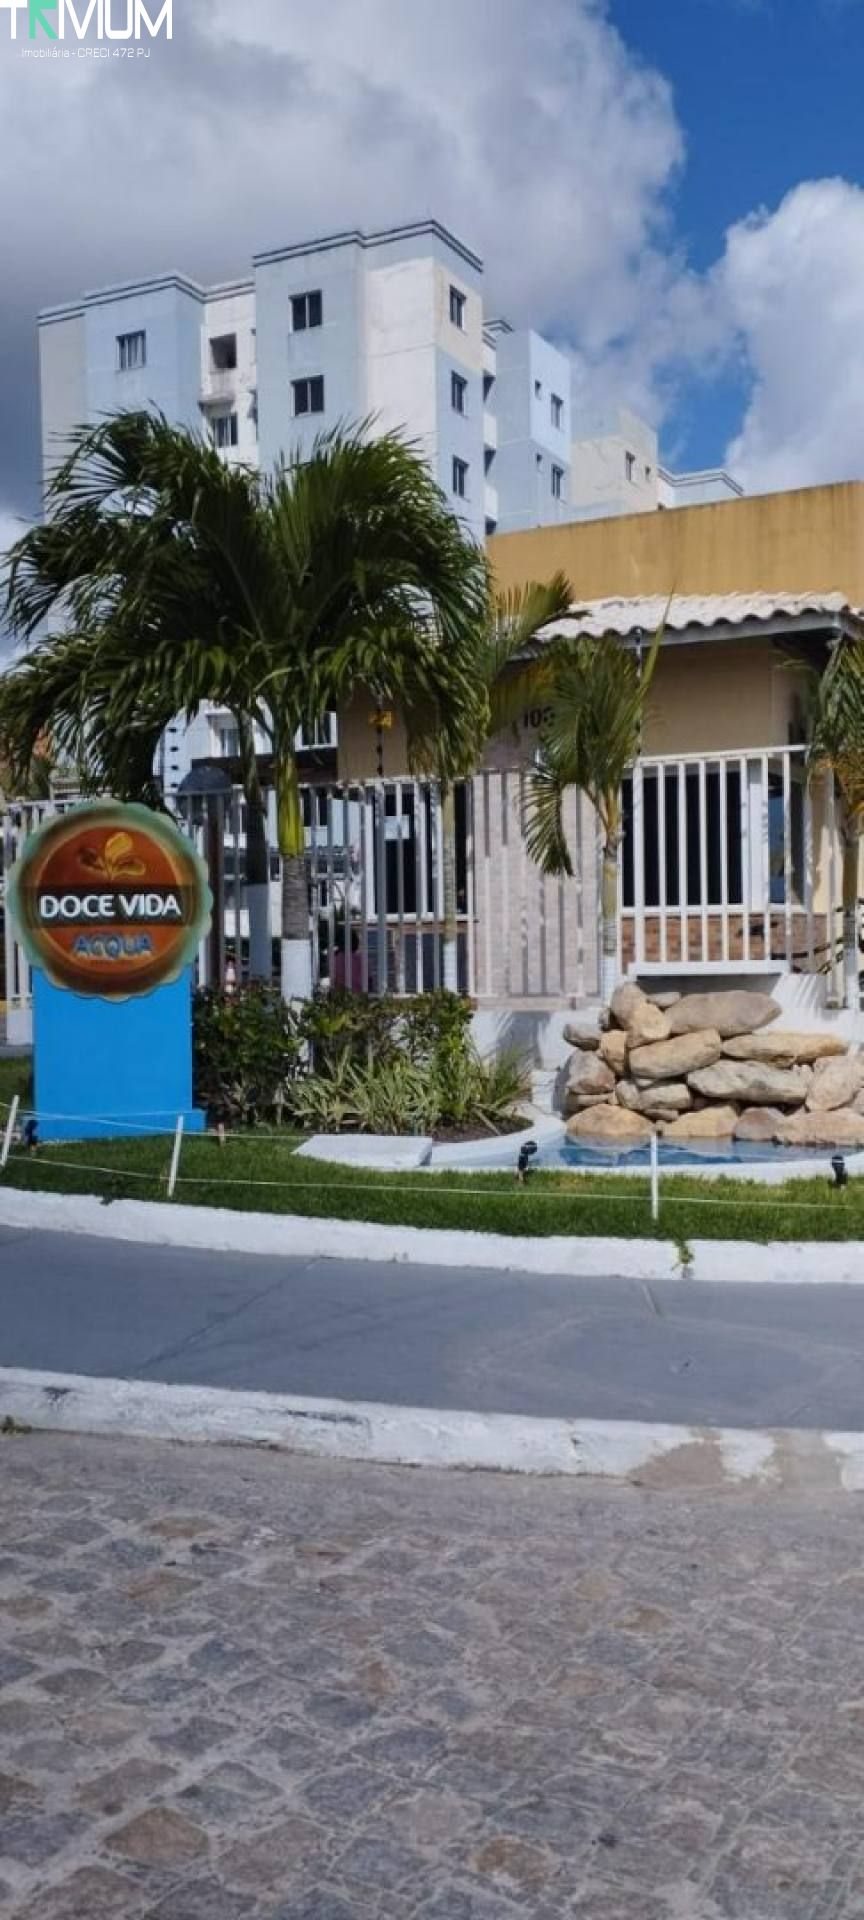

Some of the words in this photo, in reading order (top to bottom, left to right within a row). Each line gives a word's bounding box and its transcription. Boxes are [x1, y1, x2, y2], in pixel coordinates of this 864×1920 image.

[39, 894, 115, 918] DOCE
[119, 893, 182, 917] VIDA
[74, 935, 153, 959] ACQUA
